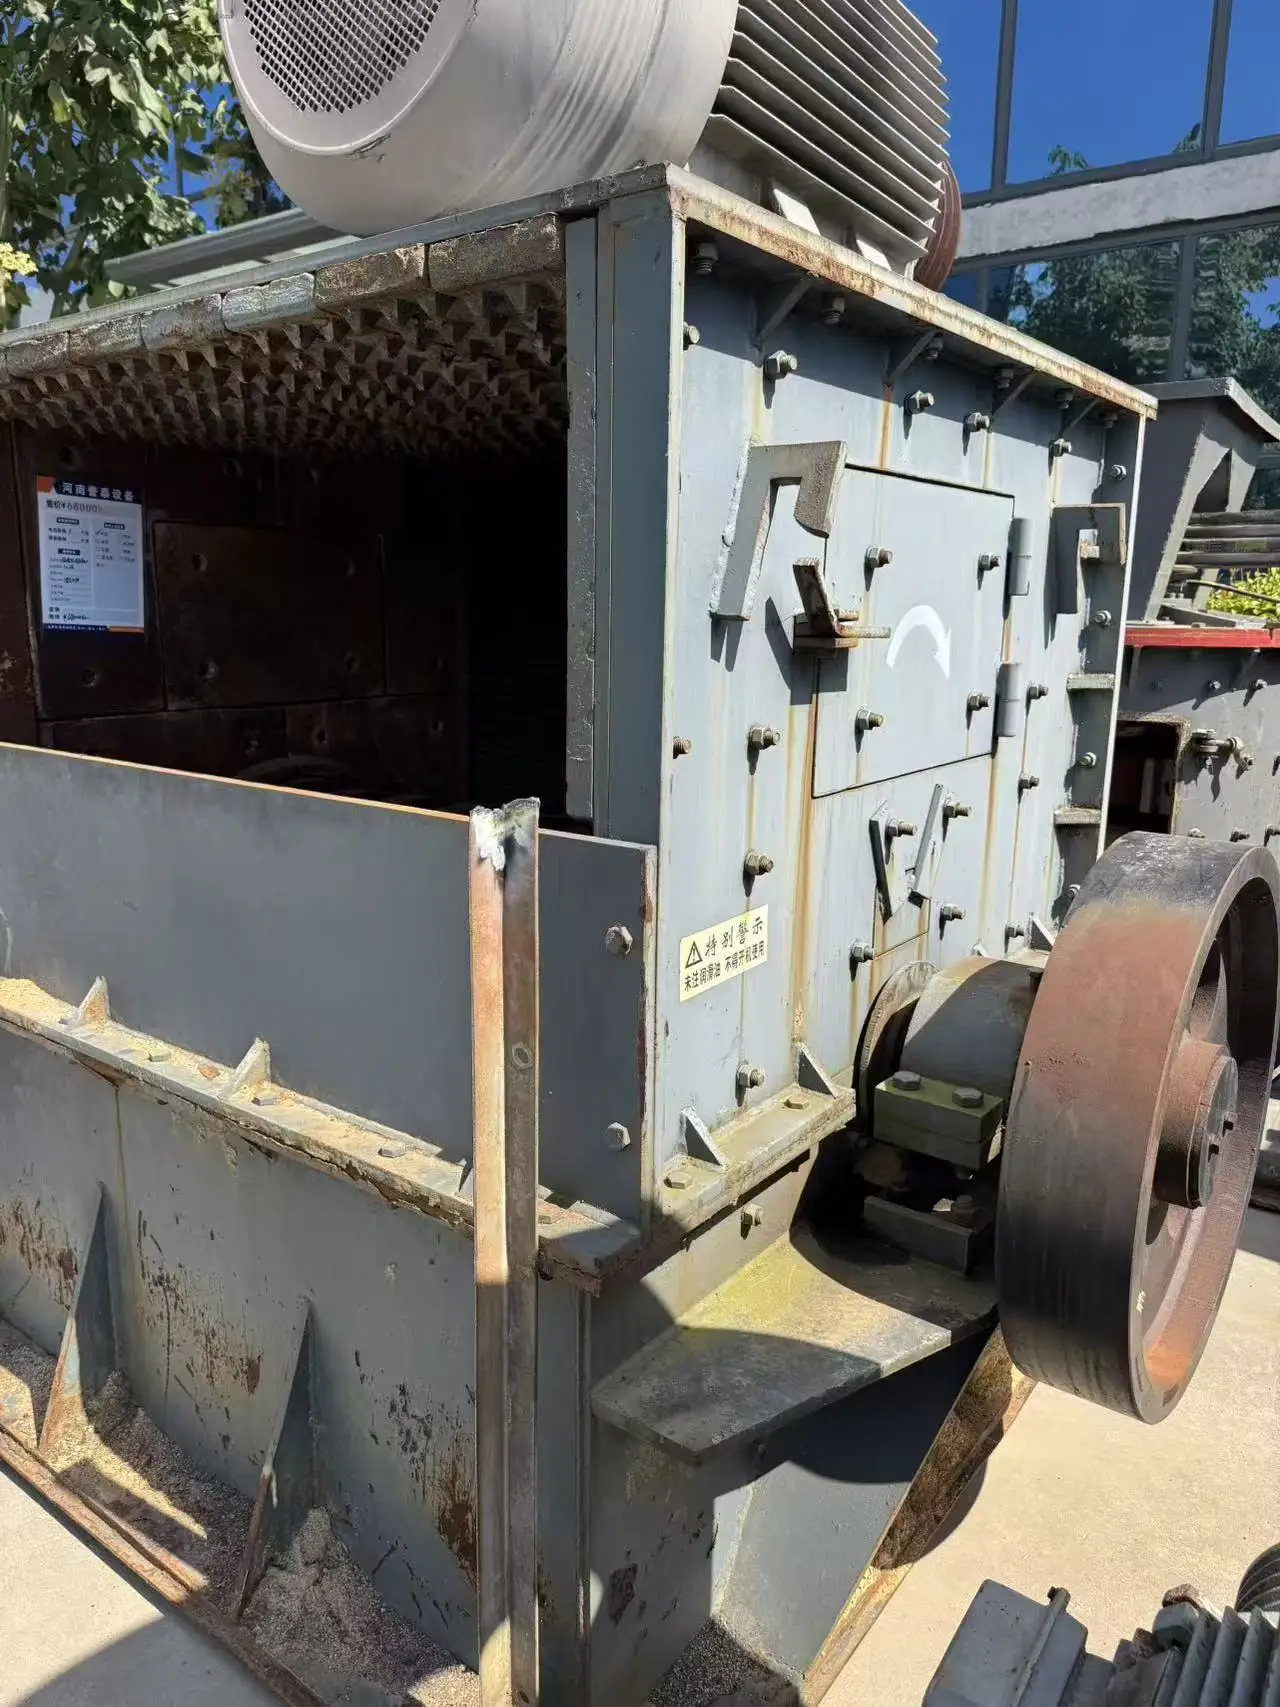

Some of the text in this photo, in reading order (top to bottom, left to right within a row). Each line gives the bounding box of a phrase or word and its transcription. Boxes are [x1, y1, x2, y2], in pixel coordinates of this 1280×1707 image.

[705, 916, 763, 957] 特别警示
[684, 940, 765, 992] 未注润滑油 不得开机使用
